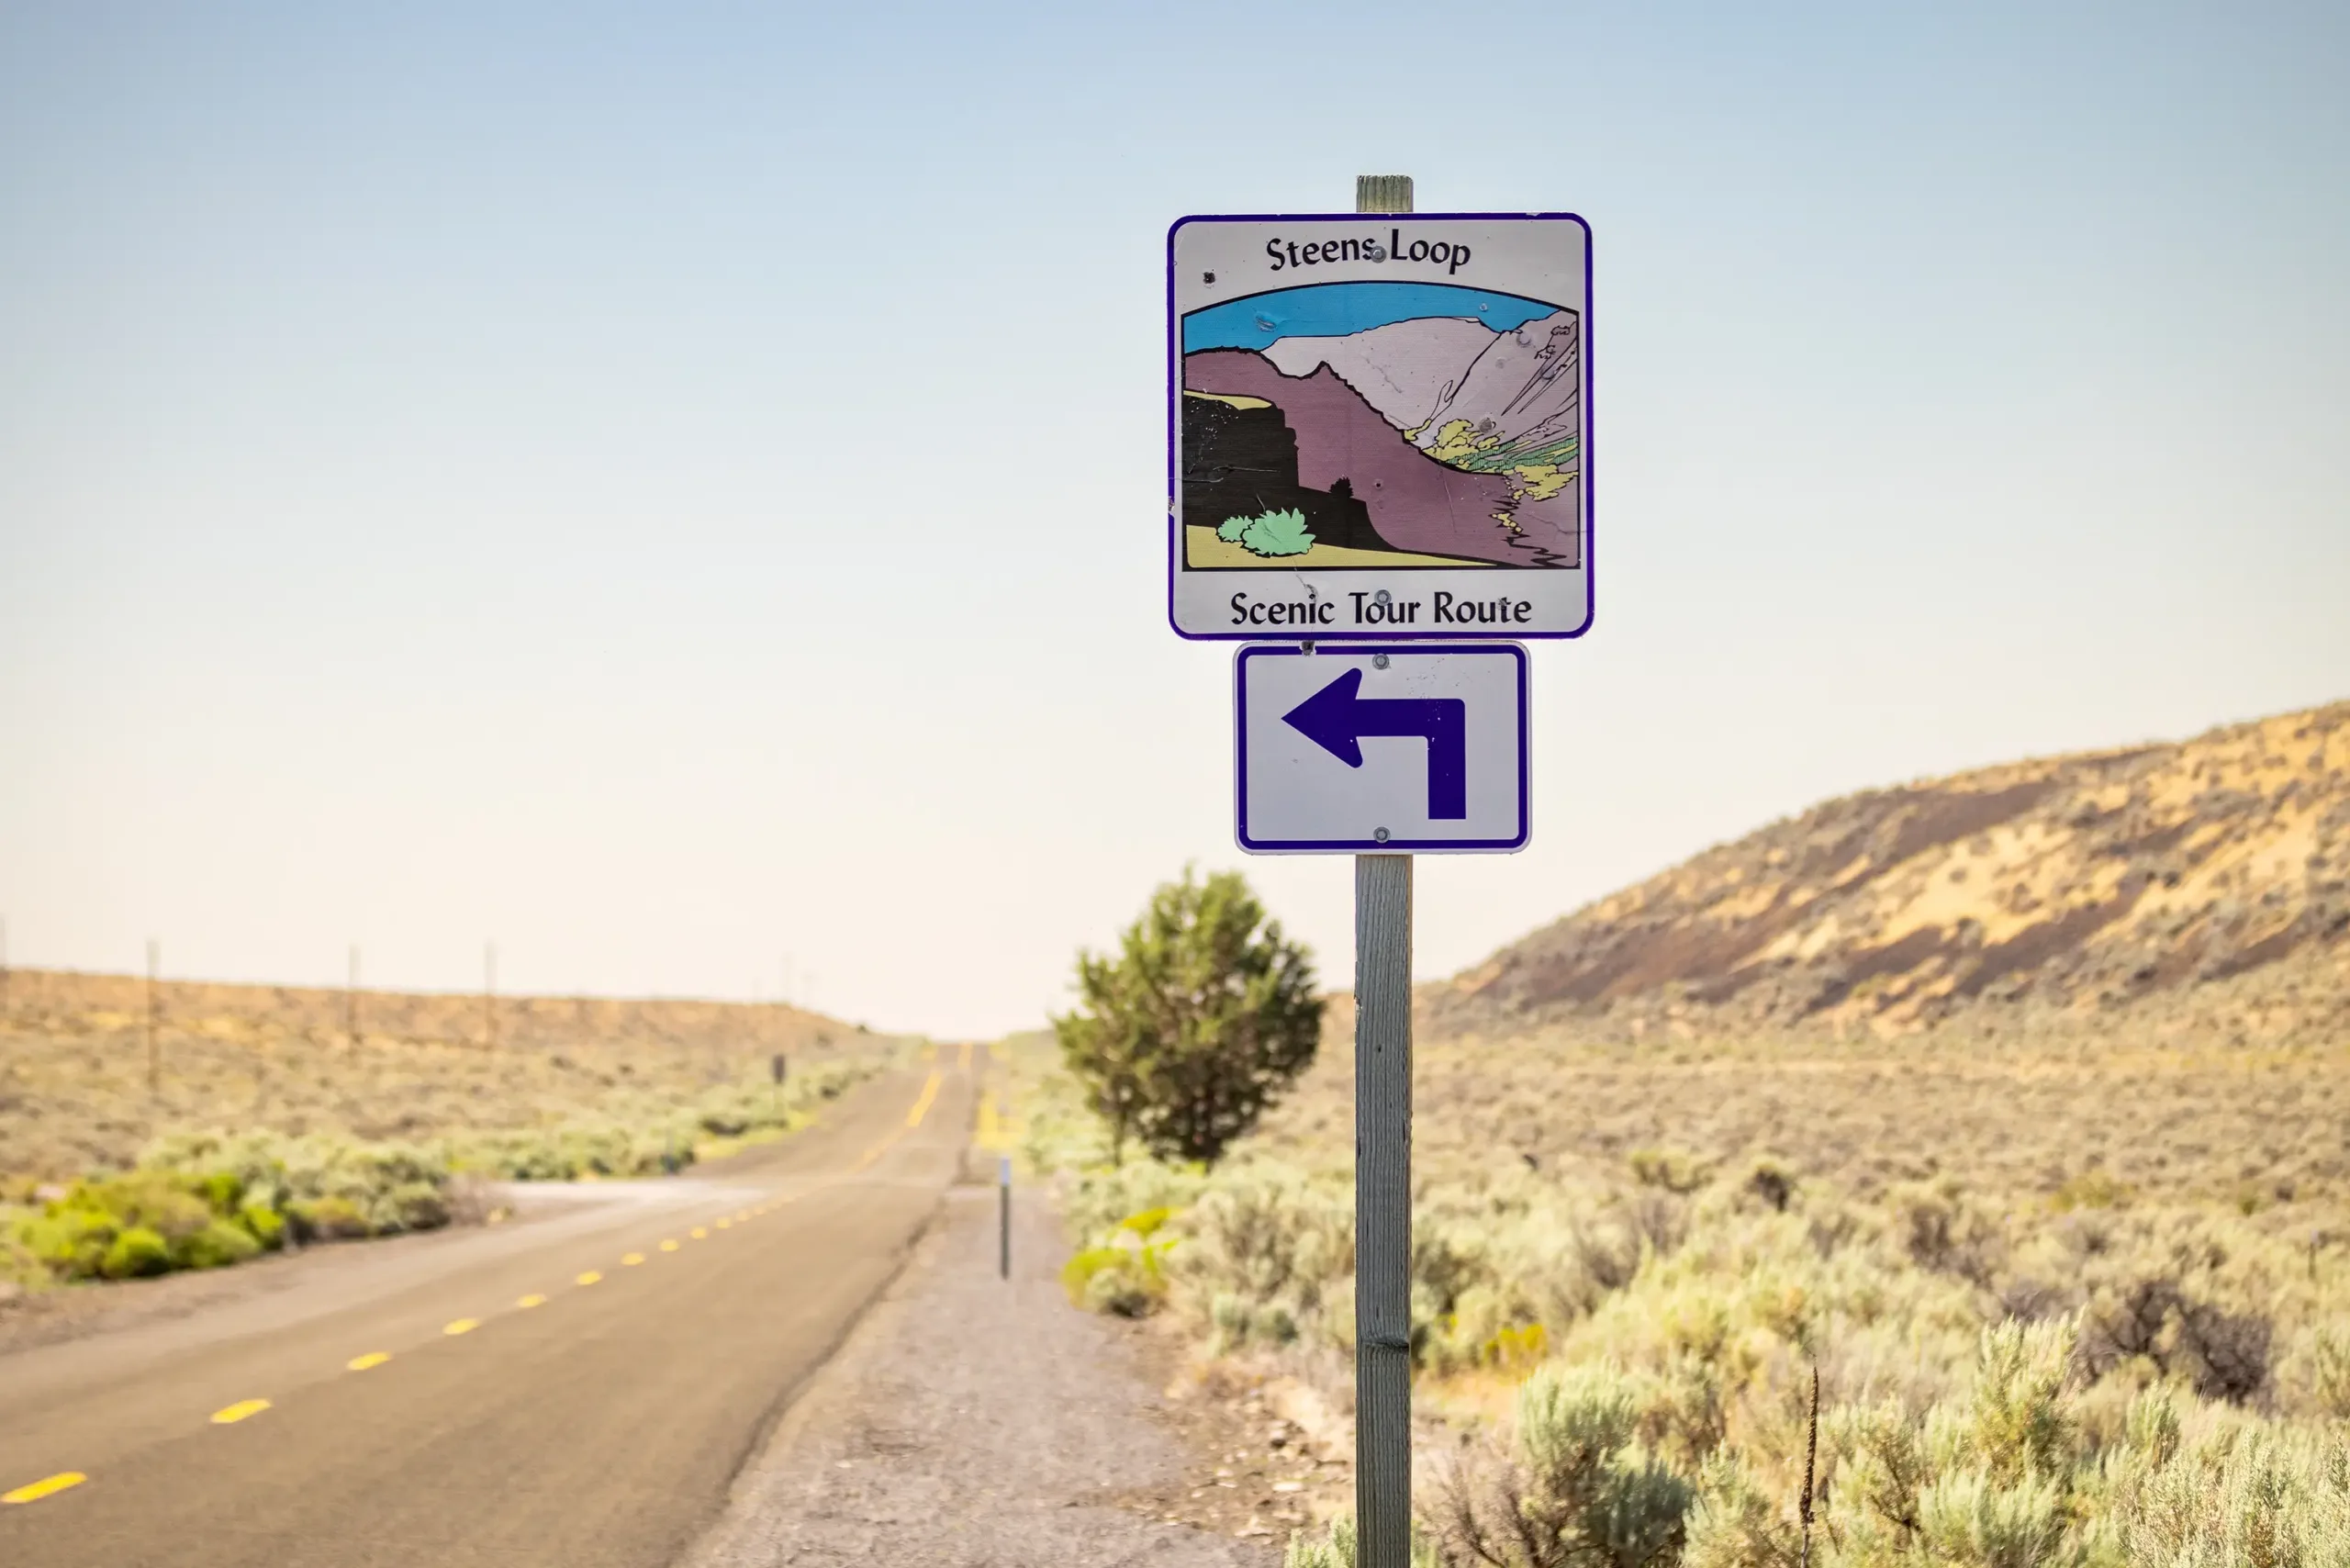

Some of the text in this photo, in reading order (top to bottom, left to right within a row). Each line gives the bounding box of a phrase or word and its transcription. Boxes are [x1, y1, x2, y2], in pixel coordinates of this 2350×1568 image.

[1266, 228, 1472, 275] Steens Loop
[1230, 590, 1533, 625] Scenic Tour Route
